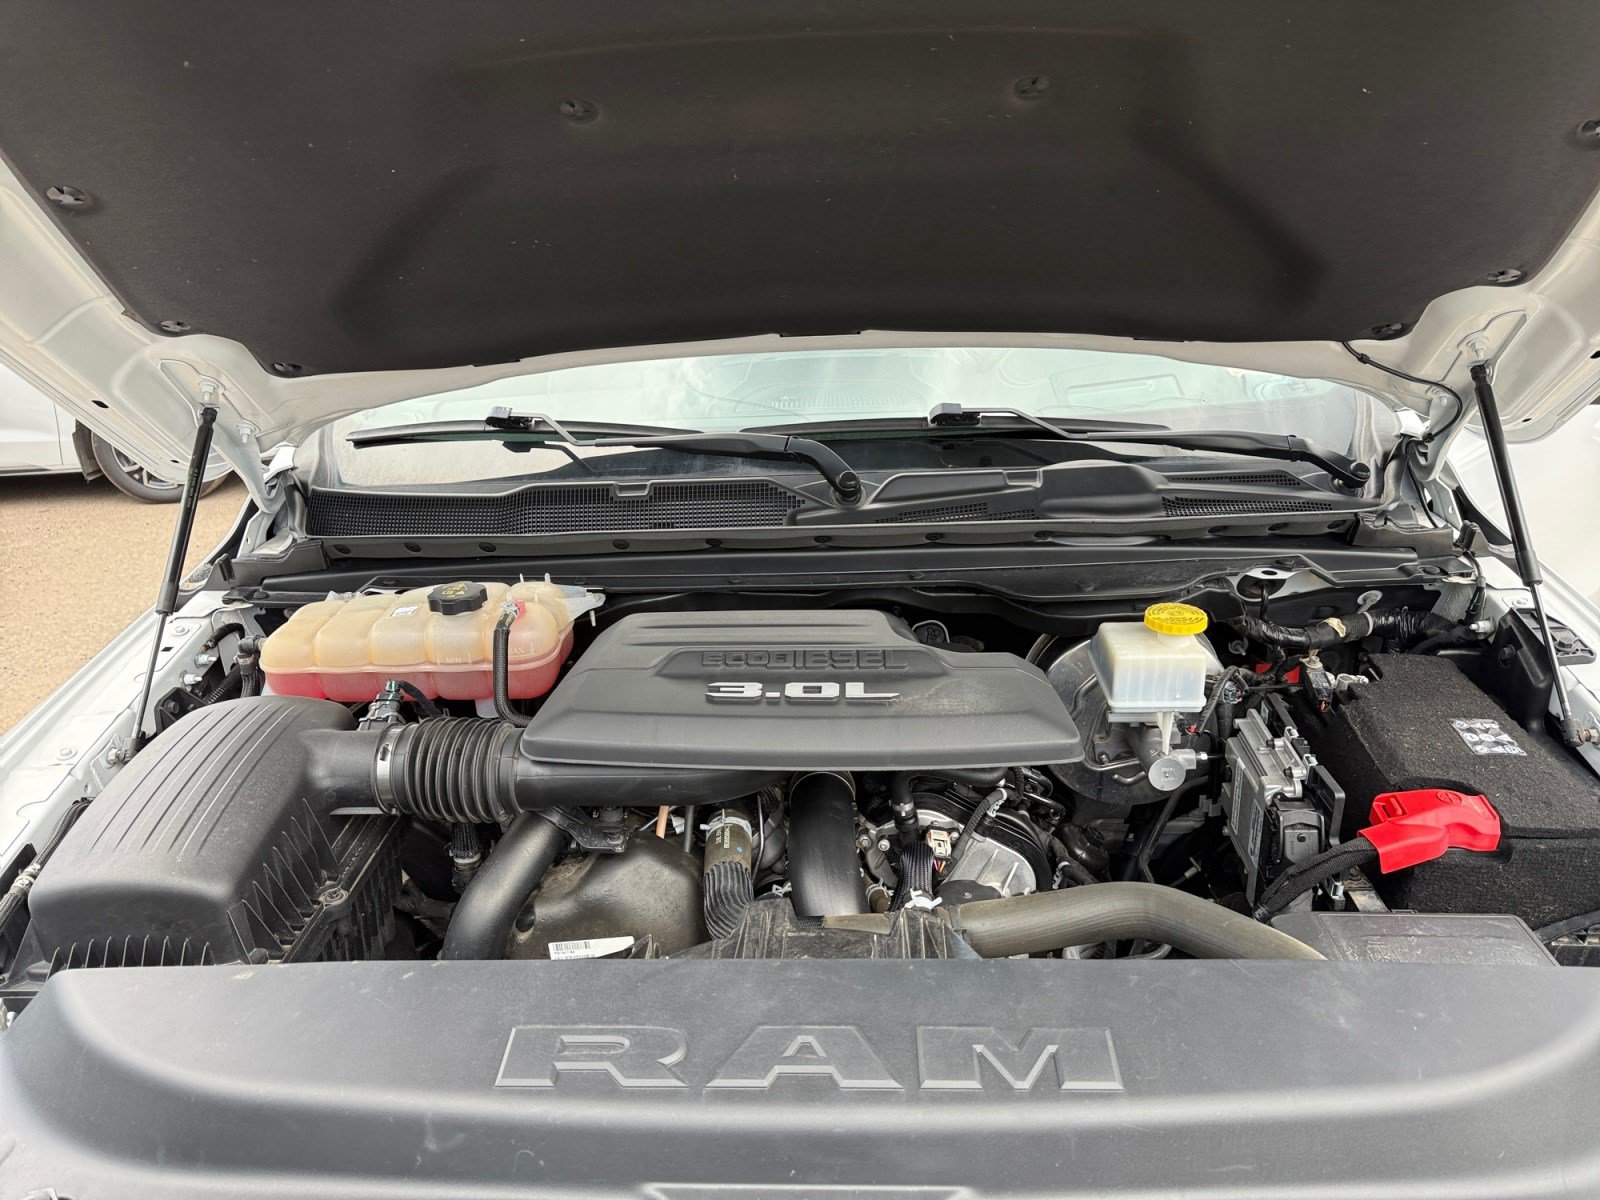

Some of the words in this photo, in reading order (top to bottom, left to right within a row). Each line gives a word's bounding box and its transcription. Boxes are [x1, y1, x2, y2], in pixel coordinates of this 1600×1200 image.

[702, 649, 909, 670] ECODIESEL
[705, 681, 900, 704] 3.0L
[494, 1025, 1125, 1090] RAM
